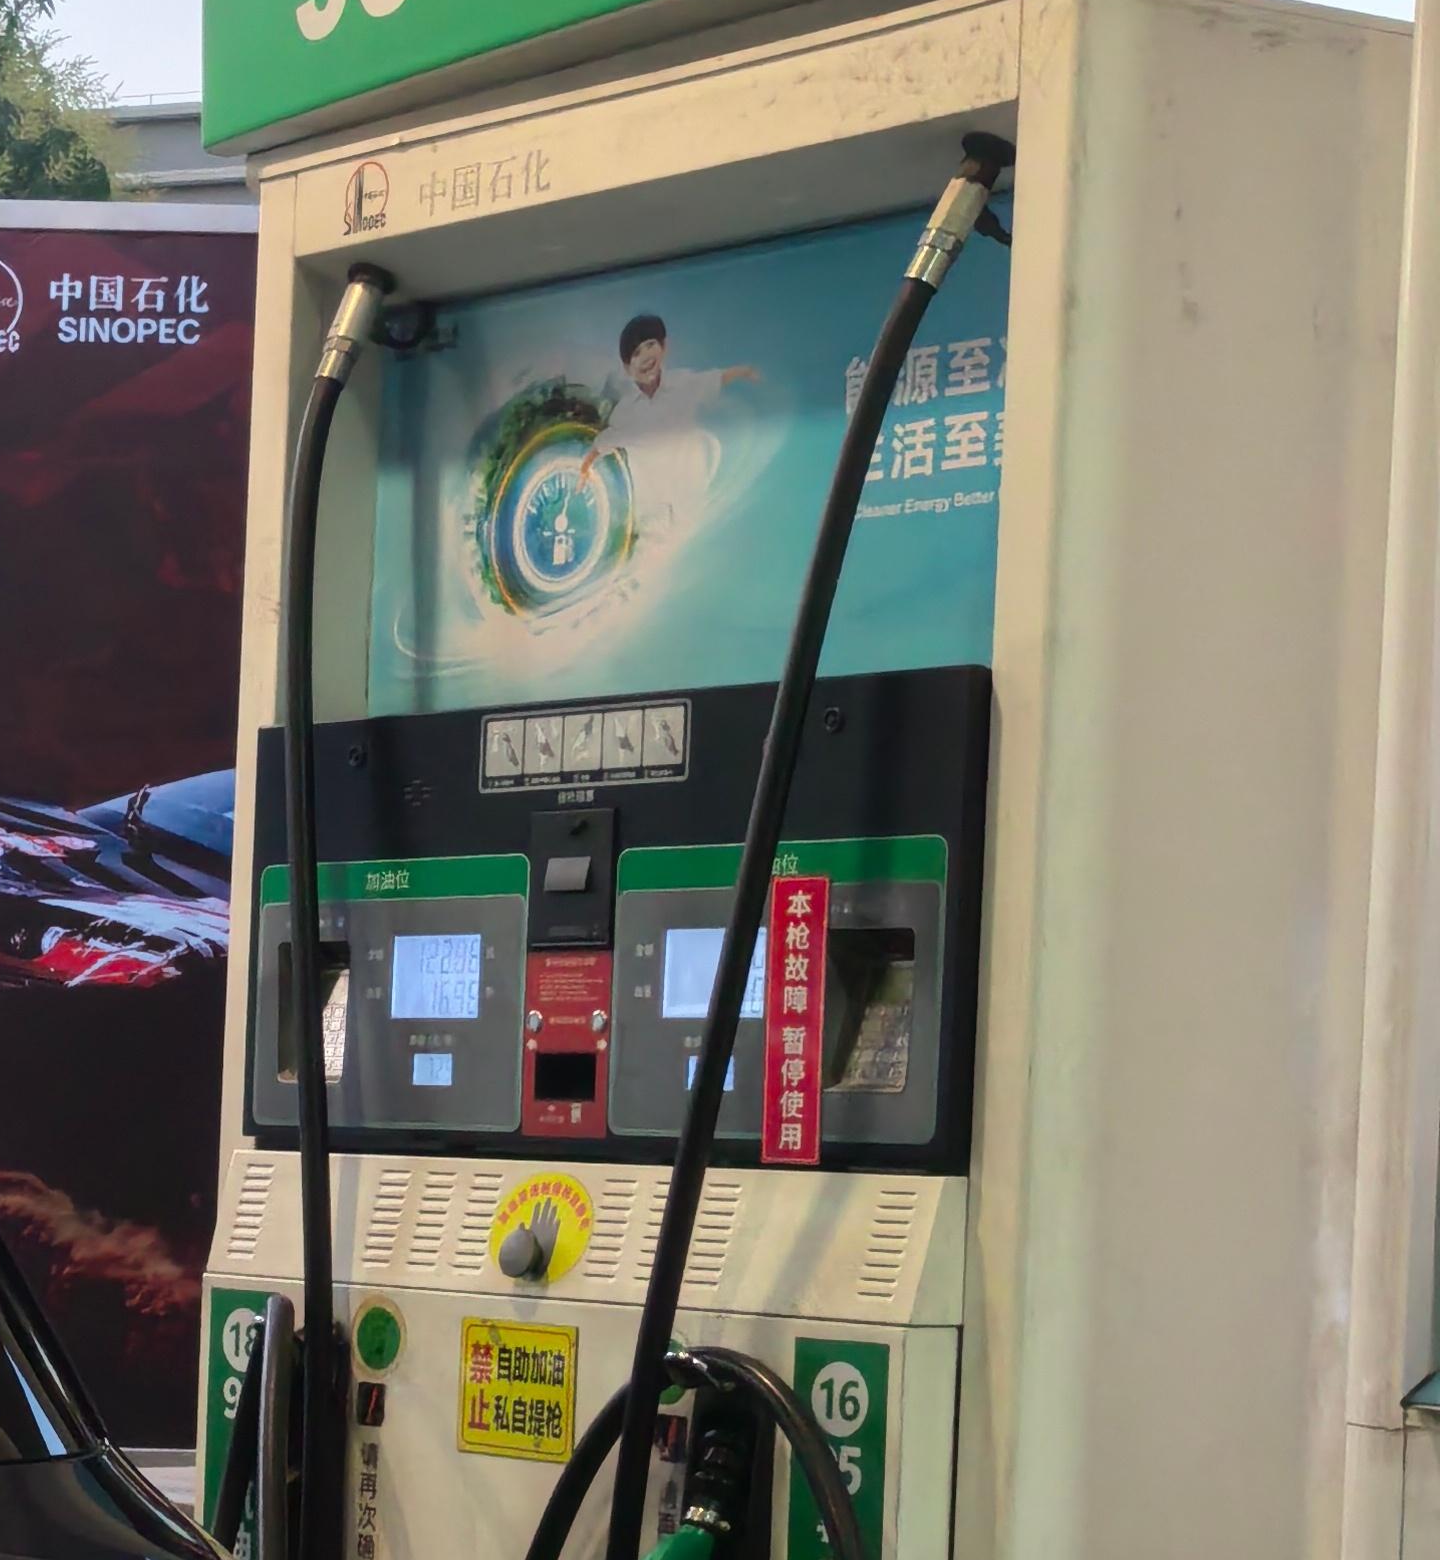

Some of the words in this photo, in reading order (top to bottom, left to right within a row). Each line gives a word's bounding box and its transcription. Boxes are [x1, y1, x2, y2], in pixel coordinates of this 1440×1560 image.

[420, 149, 550, 217] 中国石化
[49, 273, 209, 313] 中国石化
[57, 317, 201, 345] SINOPEC
[865, 411, 1003, 482] 活至
[783, 890, 814, 1014] 本枪故障
[778, 1026, 807, 1151] 暂停使用
[496, 1345, 565, 1388] 自助加油
[493, 1394, 563, 1439] 私自提枪
[820, 1378, 860, 1423] 16
